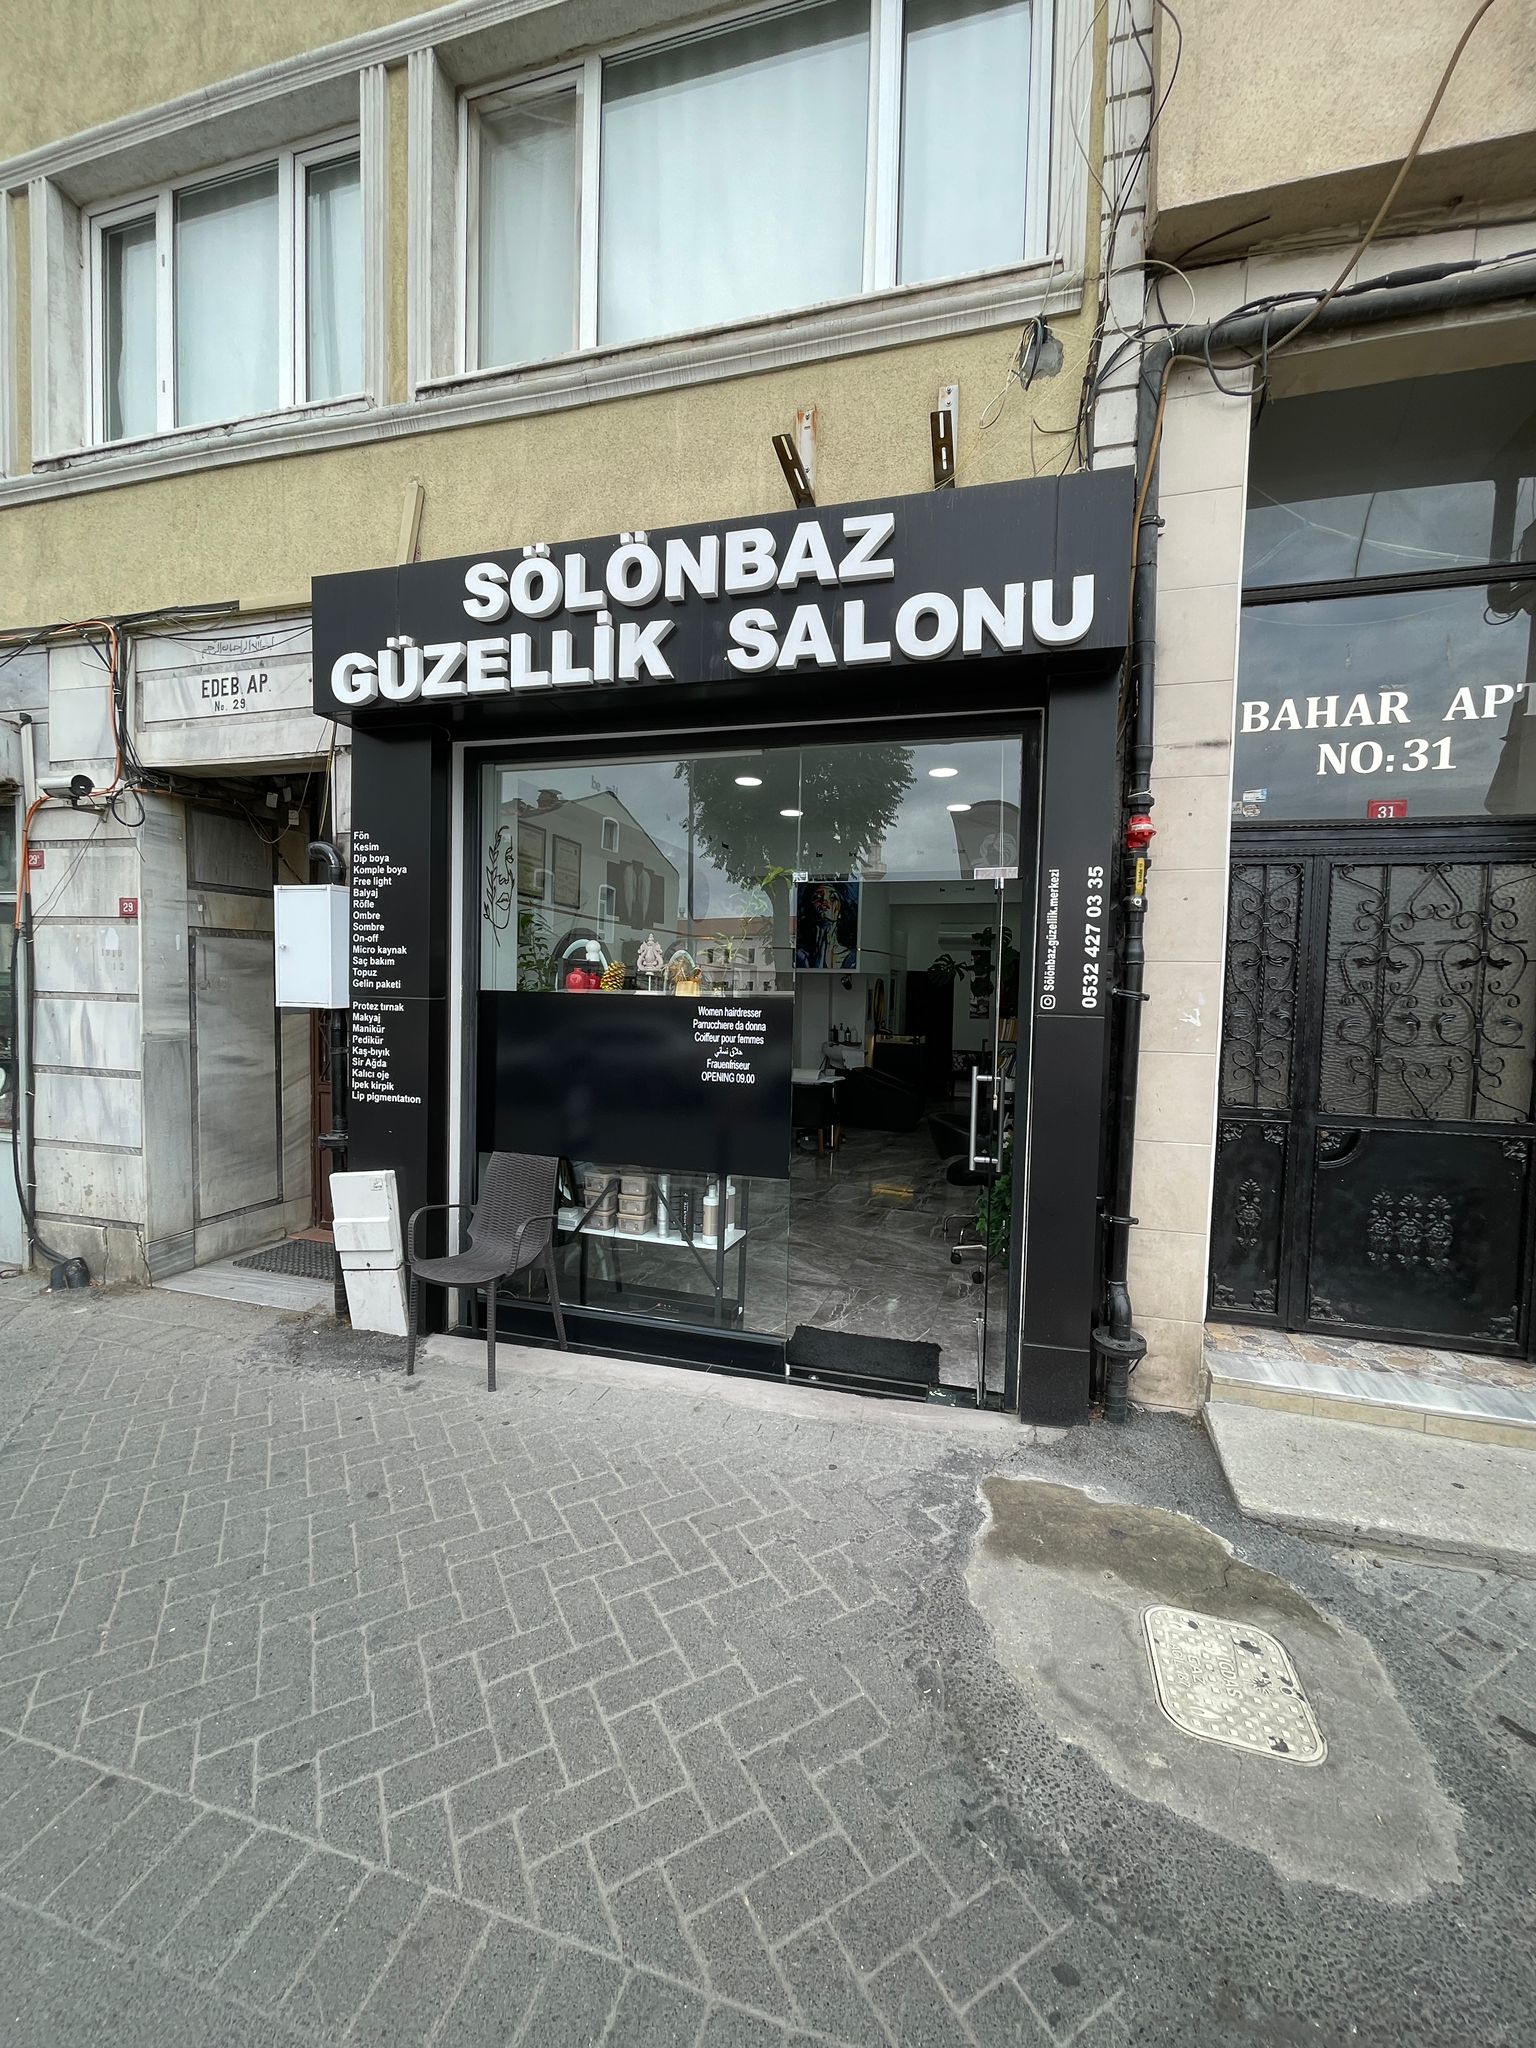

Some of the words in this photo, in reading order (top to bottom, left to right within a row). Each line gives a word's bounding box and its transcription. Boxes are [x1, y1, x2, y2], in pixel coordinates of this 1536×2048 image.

[462, 513, 895, 622] SÖLÖNBAZ
[330, 610, 676, 708] GÜZELLİK
[725, 574, 1095, 672] SALONU
[233, 698, 246, 710] 29
[1240, 691, 1411, 733] BAHAR
[1317, 736, 1457, 776] NO:31
[1377, 805, 1395, 819] 31
[353, 831, 369, 840] Fön
[353, 843, 379, 851] Kesim
[353, 854, 367, 864] Dip
[369, 854, 389, 864] boya
[353, 865, 384, 875] Komple
[386, 865, 407, 875] boya
[353, 877, 371, 886] Free
[373, 877, 392, 887] light
[1087, 866, 1104, 889] 35
[353, 888, 378, 898] Balyaj
[123, 902, 133, 912] 29
[353, 899, 374, 908] Röfle
[1085, 894, 1102, 918] 03
[352, 911, 380, 920] Ombre
[352, 922, 384, 931] Sombre
[1043, 869, 1060, 991] Sölönbaz.güzellik.merkezi
[352, 933, 378, 943] On-off
[1084, 923, 1101, 958] 427
[352, 945, 375, 954] Micro
[377, 945, 407, 956] kaynak
[352, 956, 367, 967] Saç
[370, 957, 395, 966] bakım
[352, 968, 377, 978] Topuz
[352, 979, 373, 988] Gelin
[375, 980, 401, 990] paketi
[1081, 963, 1099, 1009] 0532
[352, 1001, 378, 1011] Protez
[380, 1002, 404, 1012] tırnak
[698, 1006, 723, 1016] Women
[724, 1007, 762, 1018] hairdresser
[352, 1012, 380, 1024] Makyaj
[352, 1024, 385, 1034] Manikür
[735, 1020, 744, 1031] da
[745, 1021, 766, 1032] donna
[352, 1035, 384, 1045] Pedikür
[694, 1032, 720, 1043] Coiffeur
[721, 1034, 736, 1045] pour
[737, 1033, 765, 1045] femmes
[352, 1046, 390, 1058] Kaş-bıyık
[351, 1057, 364, 1067] Sir
[365, 1058, 387, 1069] Ağda
[706, 1058, 750, 1070] Frauenfriseur
[351, 1068, 375, 1078] Kalıcı
[376, 1070, 389, 1080] oje
[736, 1073, 755, 1084] 09.00
[351, 1078, 369, 1090] İpek
[371, 1081, 394, 1091] kirpik
[351, 1091, 364, 1101] Lip
[1188, 1655, 1207, 1685] GAZ
